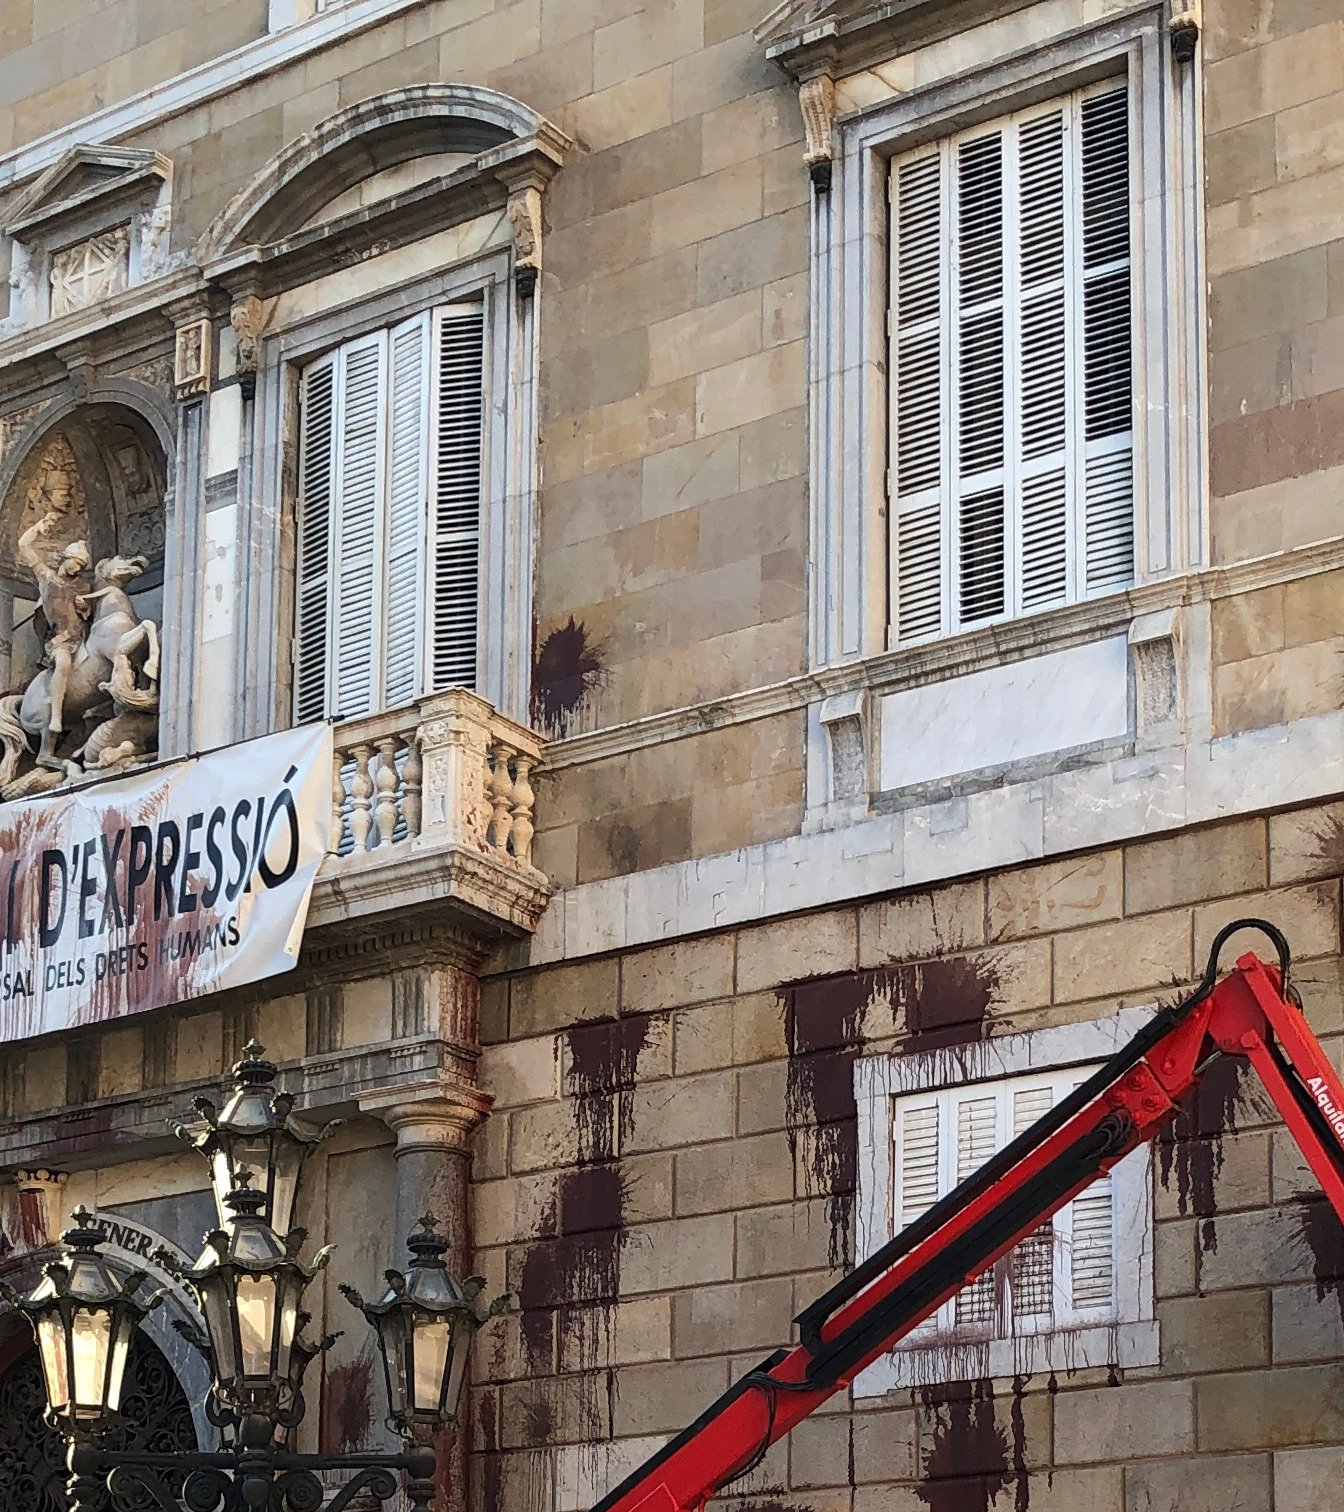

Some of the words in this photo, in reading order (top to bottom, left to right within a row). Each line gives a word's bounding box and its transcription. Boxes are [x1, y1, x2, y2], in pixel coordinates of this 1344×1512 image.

[7, 859, 20, 955] I
[39, 765, 300, 949] D'EXPRESSIÓ
[45, 957, 86, 992] DELS
[95, 942, 149, 981] DRETS
[159, 916, 240, 965] HUMANS
